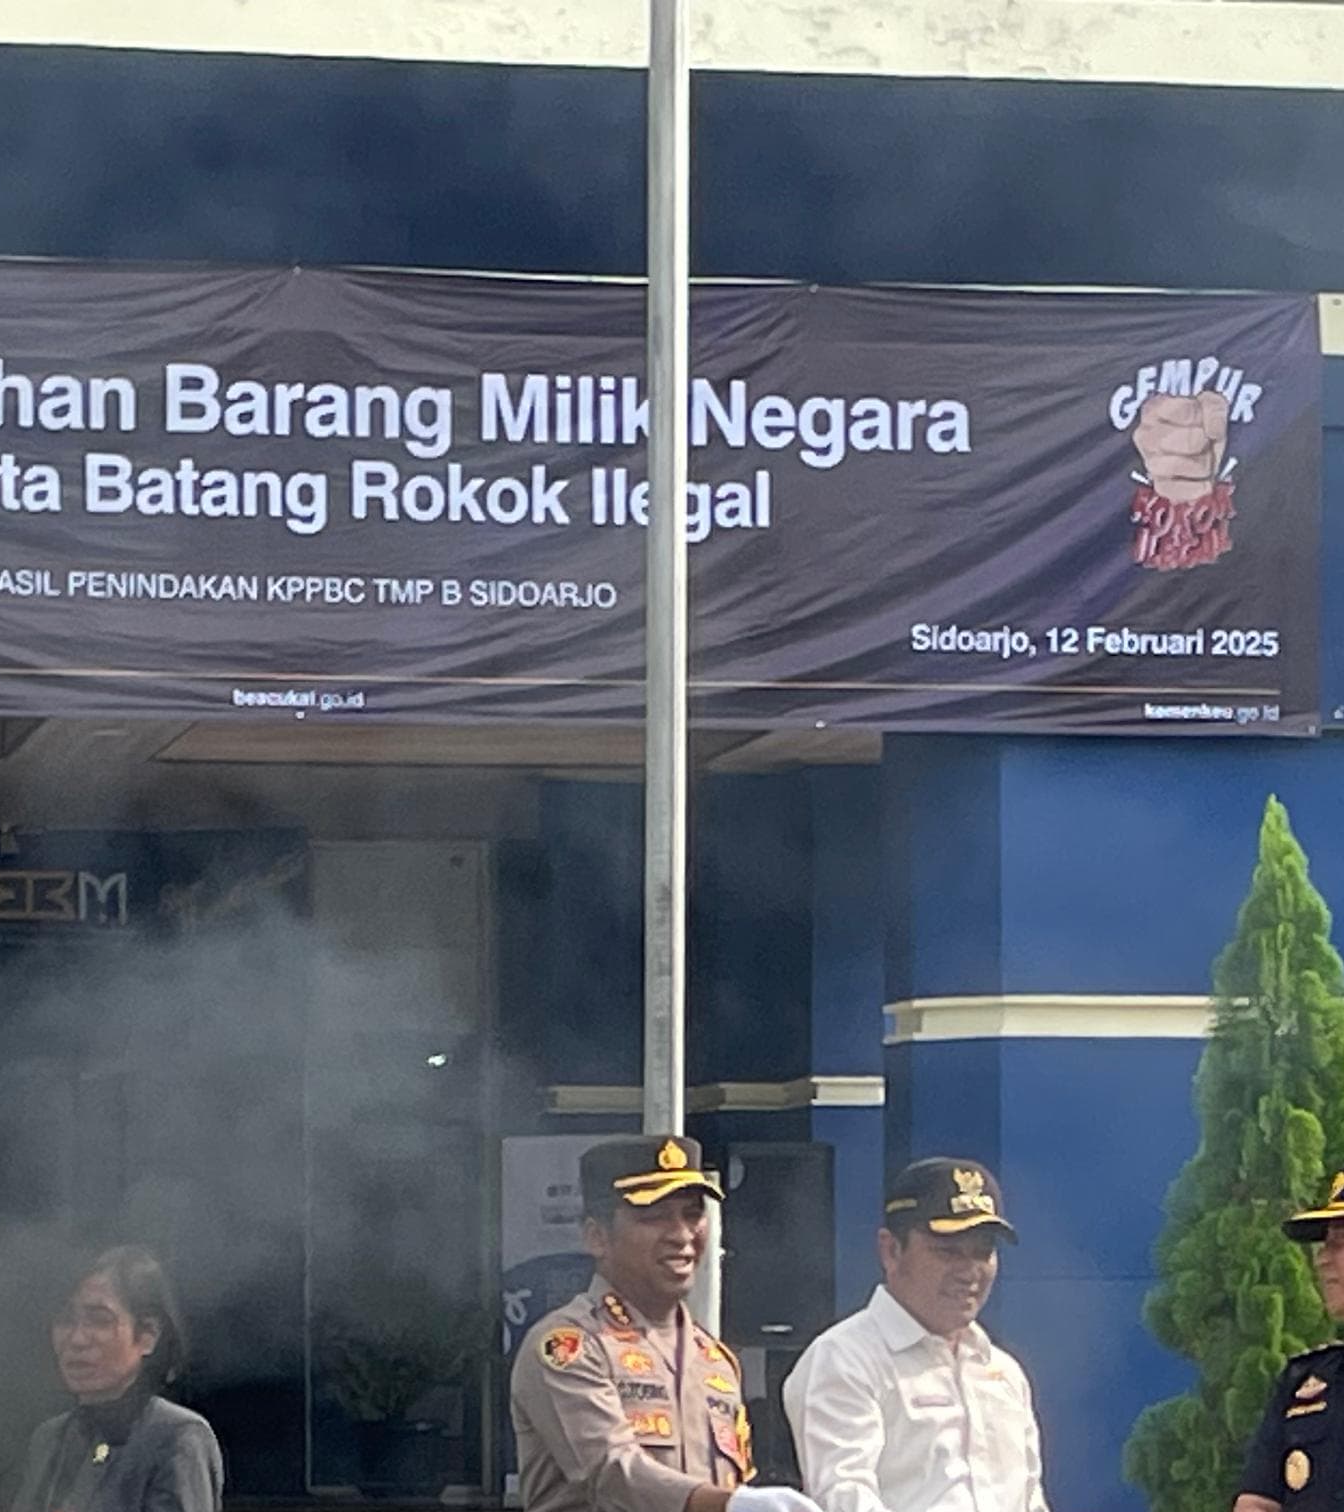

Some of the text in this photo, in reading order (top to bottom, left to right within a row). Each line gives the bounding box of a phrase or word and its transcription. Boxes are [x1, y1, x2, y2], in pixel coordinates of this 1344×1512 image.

[165, 363, 453, 458] Barang
[480, 373, 650, 444] Milik
[691, 378, 972, 468] Negara
[1109, 356, 1262, 430] GEMPUR
[85, 453, 328, 535] Batang
[351, 460, 571, 525] Rokok
[68, 571, 258, 601] PENINDAKAN
[267, 576, 366, 604] KPPBC
[373, 578, 434, 605] TMP
[441, 580, 463, 606] B
[469, 581, 618, 609] SIDOARJO
[911, 623, 1279, 658] Sidoarjo, 12 Februari 2025
